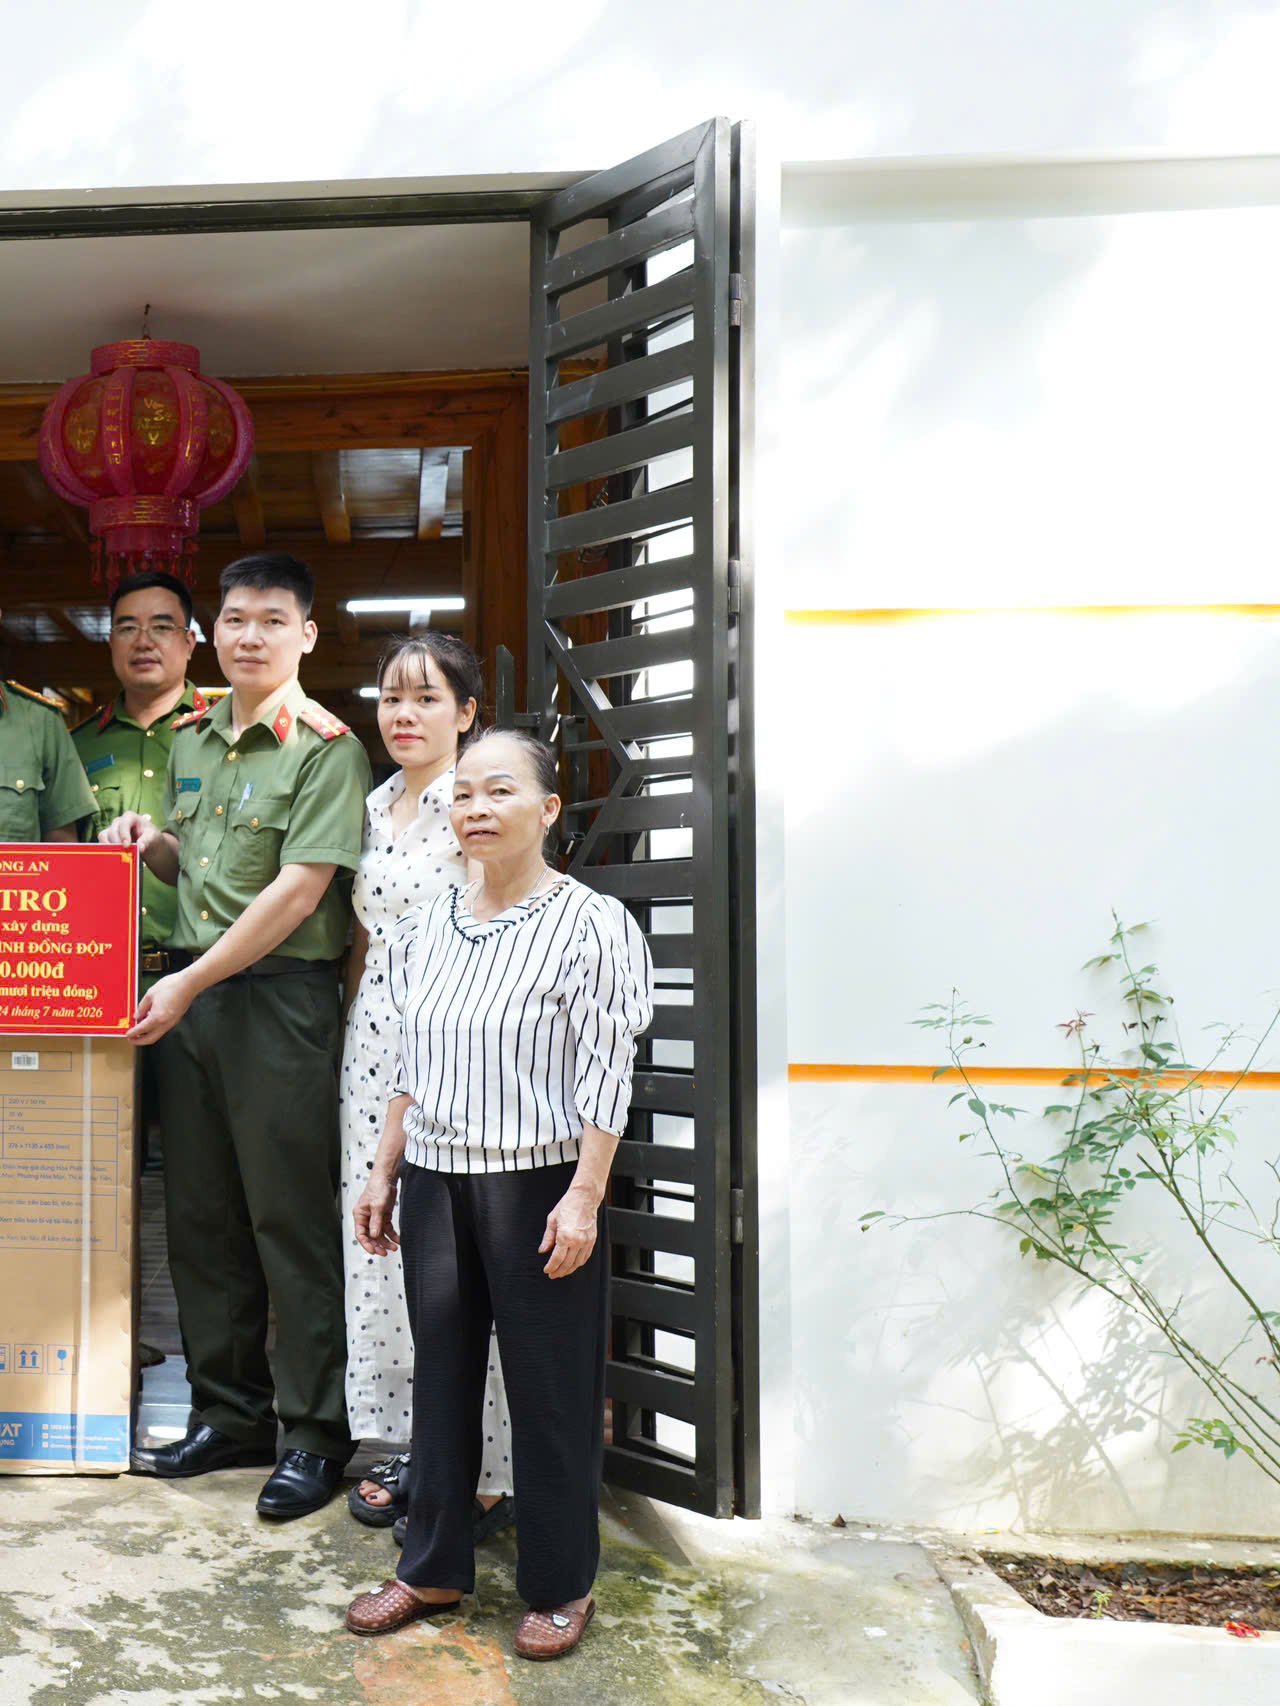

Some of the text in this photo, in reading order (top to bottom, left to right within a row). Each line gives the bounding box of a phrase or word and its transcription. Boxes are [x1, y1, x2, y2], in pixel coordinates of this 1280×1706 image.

[27, 861, 49, 872] AN
[2, 920, 28, 935] xây
[31, 919, 70, 935] dựng
[28, 937, 72, 954] ĐỒNG
[76, 940, 112, 957] ĐỘI”
[31, 984, 60, 1000] triệu
[63, 984, 98, 1000] đồng)
[11, 1005, 41, 1019] tháng
[43, 1006, 50, 1017] 7
[52, 1007, 75, 1018] năm
[77, 1007, 103, 1018] 2026
